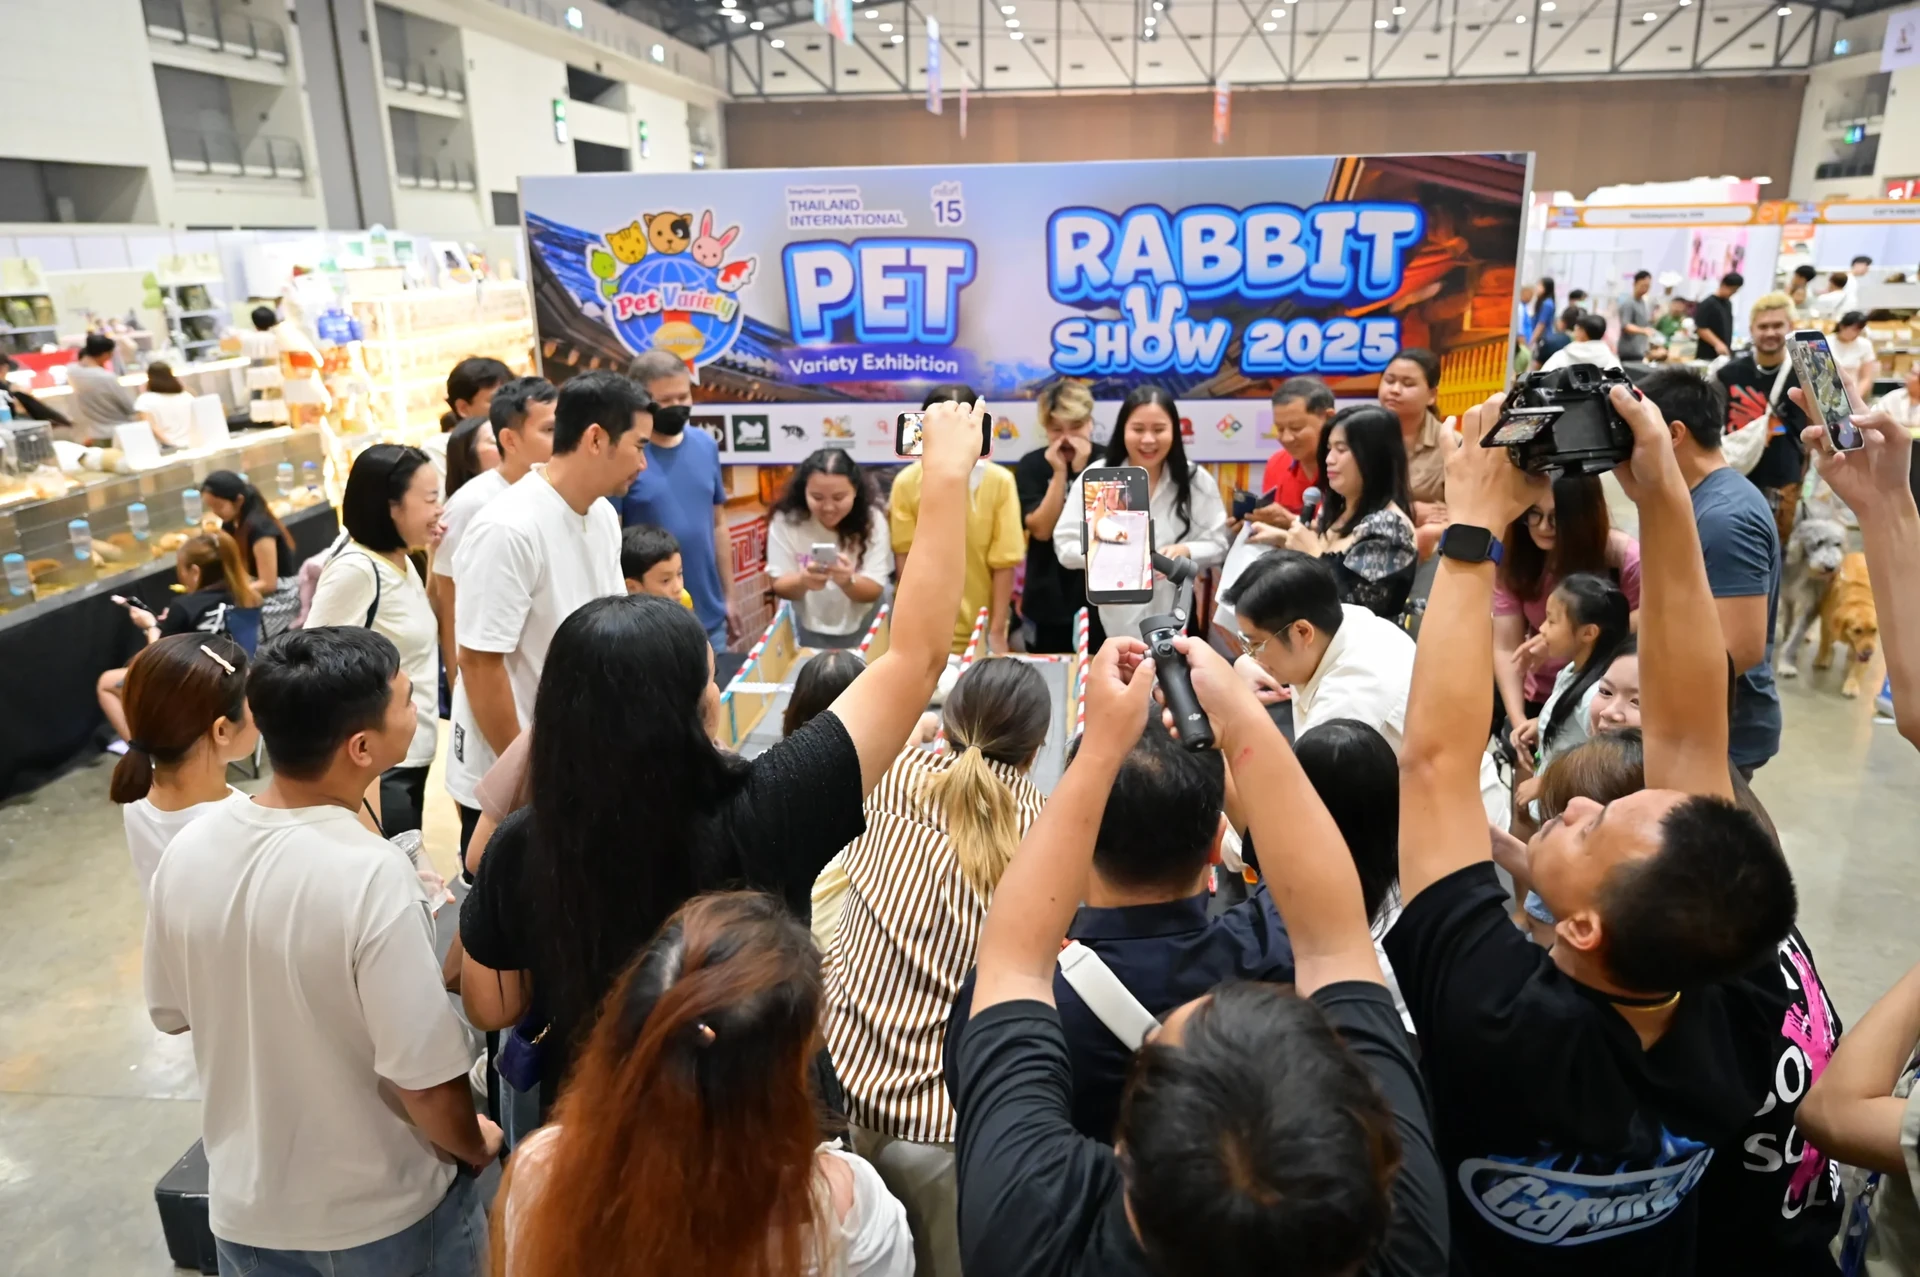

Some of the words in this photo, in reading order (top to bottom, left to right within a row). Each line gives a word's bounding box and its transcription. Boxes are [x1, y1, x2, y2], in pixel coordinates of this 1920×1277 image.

[789, 199, 860, 212] THAILAND
[790, 213, 904, 227] INTERNATIONAL
[934, 200, 962, 223] 15
[1053, 206, 1420, 295] RABBIT
[617, 292, 658, 316] Pet
[662, 286, 734, 318] Variety
[788, 244, 969, 335] PET
[1054, 303, 1229, 368] SHOW
[1246, 319, 1399, 368] 2025
[788, 356, 858, 377] Variety
[862, 351, 959, 375] Exhibition
